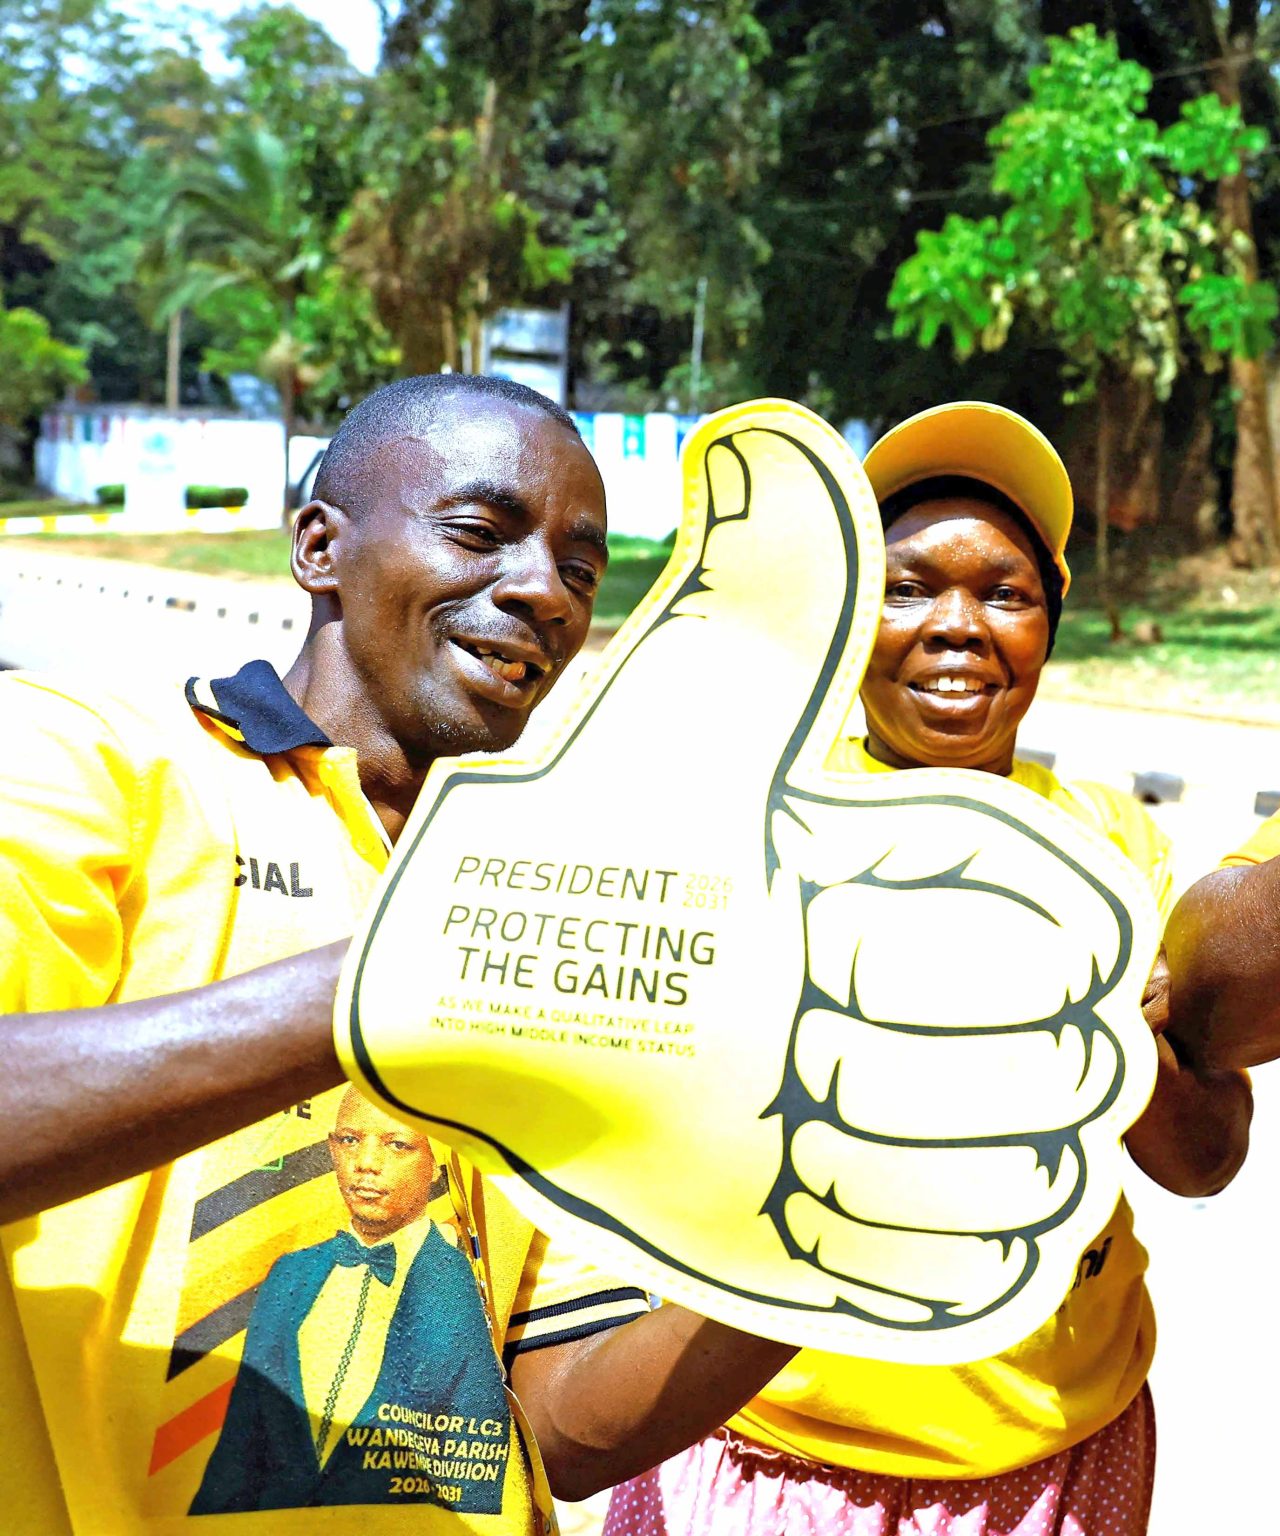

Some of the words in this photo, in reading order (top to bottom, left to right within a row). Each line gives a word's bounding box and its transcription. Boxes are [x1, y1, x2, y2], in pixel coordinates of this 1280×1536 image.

[454, 856, 678, 903] PRESIDENT
[684, 873, 733, 893] 2026
[682, 890, 728, 911] 2031
[443, 905, 716, 966] PROTECTING
[458, 946, 538, 989] THE
[553, 959, 689, 1006] GAINS
[437, 996, 456, 1009] AS
[462, 998, 483, 1012] WE
[489, 1002, 531, 1018] MAKE
[538, 1008, 545, 1019] A
[551, 1009, 648, 1032] QUALITATIVE
[654, 1020, 694, 1034] LEAP
[431, 1017, 466, 1031] INTO
[470, 1022, 506, 1036] HIGH
[511, 1027, 567, 1042] MIDDLE
[573, 1033, 632, 1049] INCOME
[638, 1040, 696, 1057] STATUS
[377, 1403, 464, 1434] COUNCILOR
[467, 1417, 503, 1437] LC3
[443, 1440, 509, 1461] PARISH
[433, 1460, 499, 1481] DIVISION
